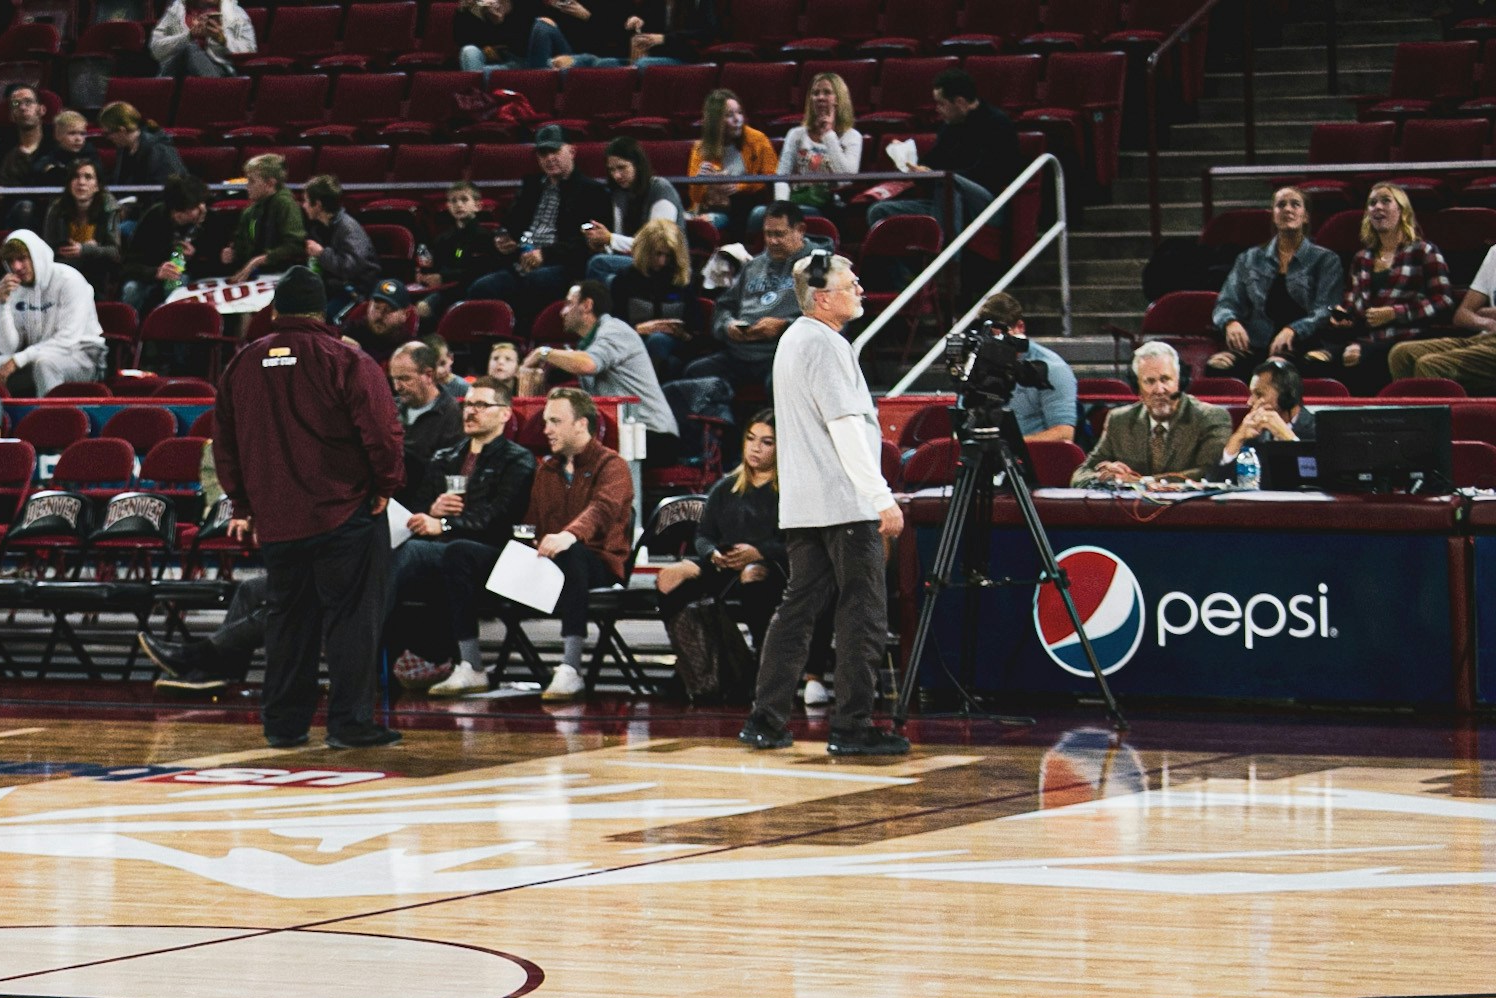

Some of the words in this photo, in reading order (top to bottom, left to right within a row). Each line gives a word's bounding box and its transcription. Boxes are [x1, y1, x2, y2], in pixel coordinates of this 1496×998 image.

[22, 497, 82, 530] DENVER
[104, 498, 166, 532] DENVER
[1157, 582, 1330, 649] pepsi
